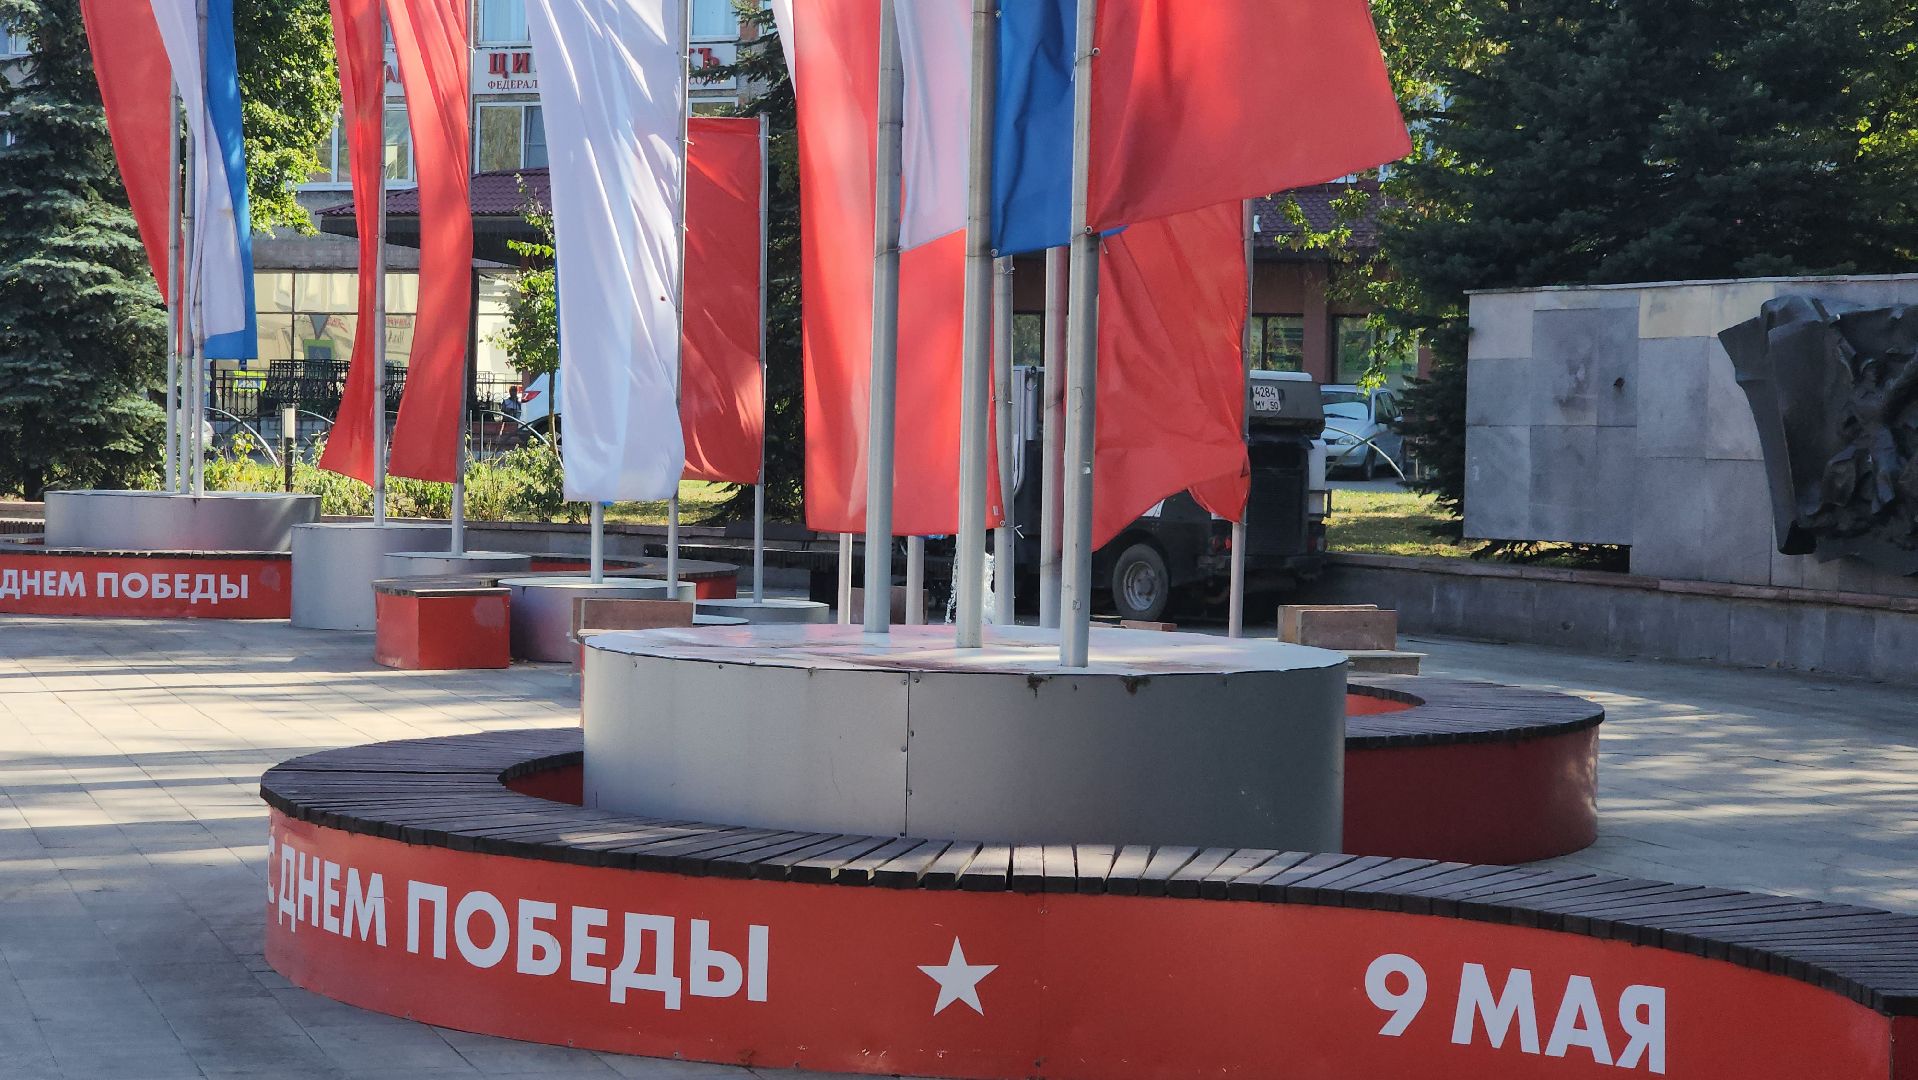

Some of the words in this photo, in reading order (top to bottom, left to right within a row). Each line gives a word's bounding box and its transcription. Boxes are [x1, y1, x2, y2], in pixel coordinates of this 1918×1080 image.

[488, 53, 536, 79] ЦИ
[1255, 387, 1276, 397] 4284
[1269, 401, 1279, 410] 50
[0, 569, 87, 599] ДНЕМ
[97, 572, 249, 604] ПОБЕДЫ
[278, 843, 387, 947] ДНЕМ
[407, 880, 769, 1010] ПОБЕДЫ
[1364, 953, 1428, 1037] 9
[1451, 962, 1666, 1075] МАЯ
